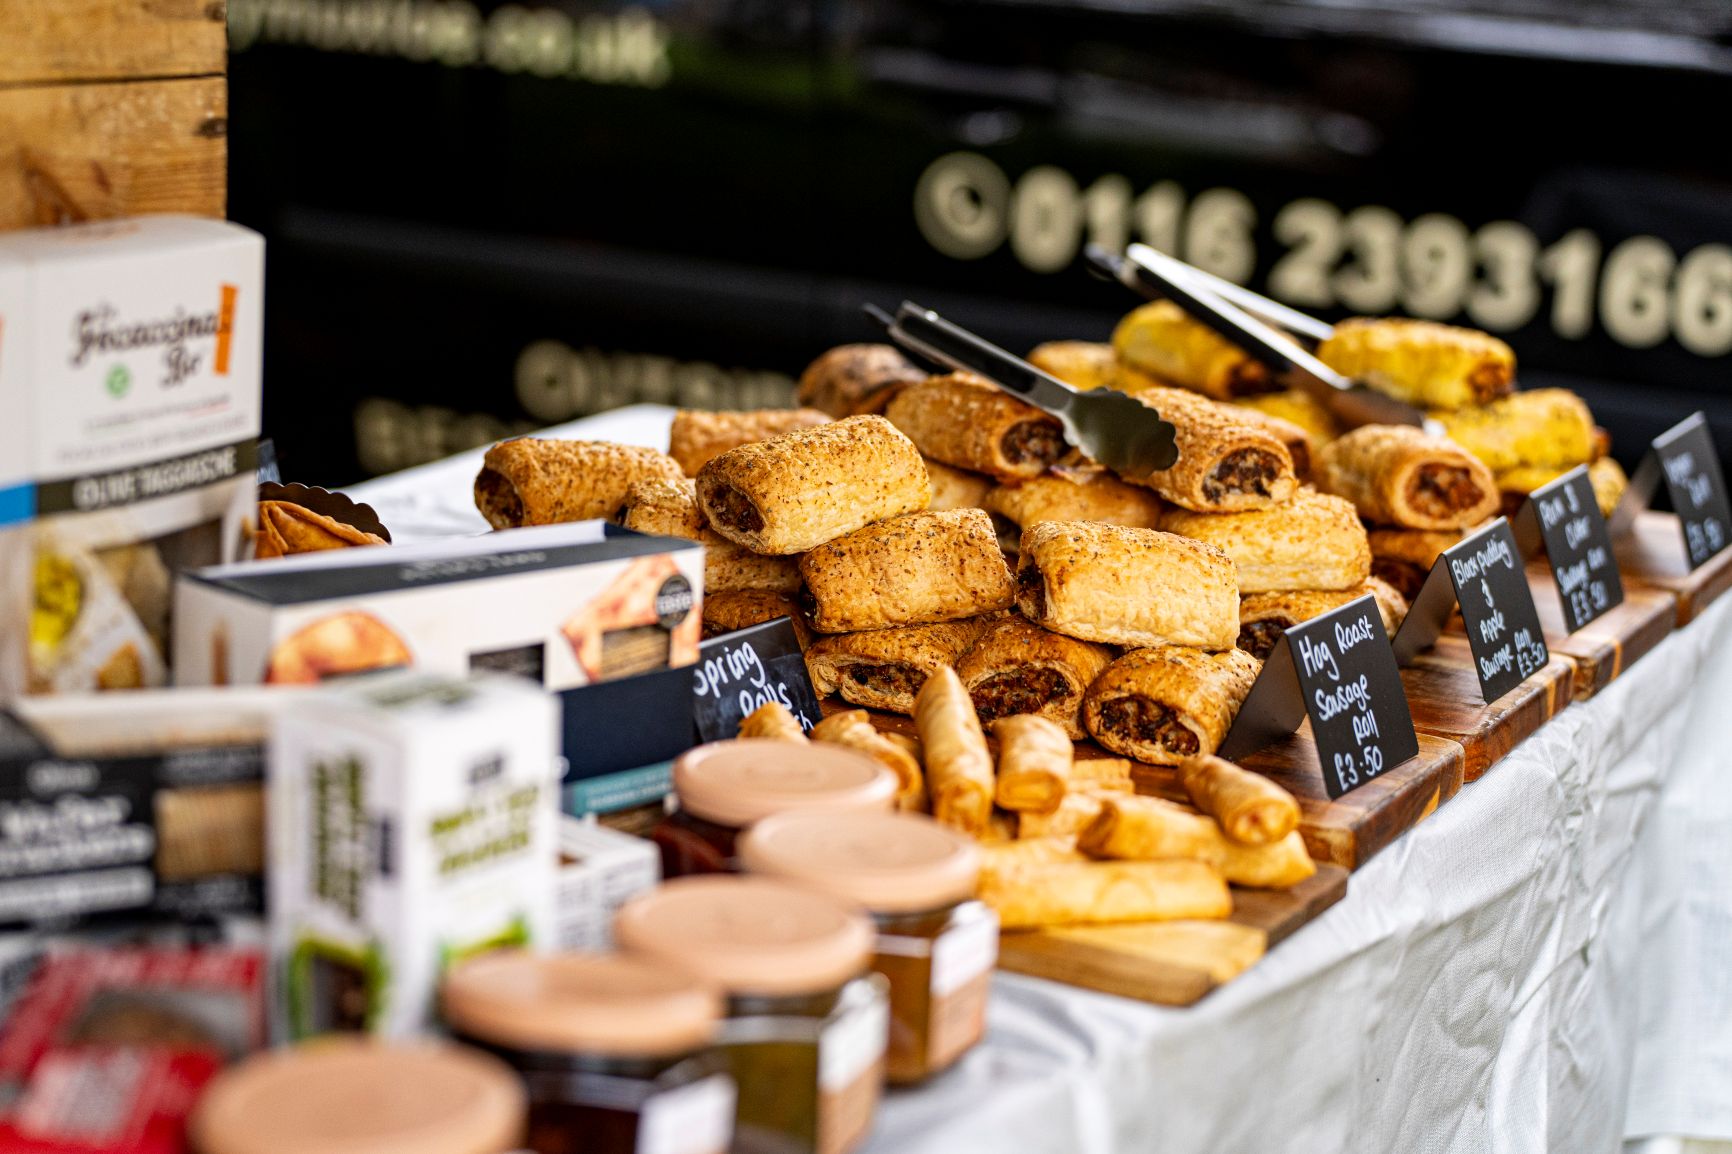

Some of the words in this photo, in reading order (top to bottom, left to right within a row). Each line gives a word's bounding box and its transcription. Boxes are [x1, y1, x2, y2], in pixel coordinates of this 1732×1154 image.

[1268, 198, 1732, 357] 2393166
[1451, 557, 1478, 589] Black
[1298, 635, 1340, 681] Hog
[1334, 615, 1374, 655] Roast
[1479, 608, 1506, 644] Apple
[1314, 673, 1371, 721] Sausage
[1352, 708, 1380, 746] Roll
[1333, 745, 1384, 792] £3.50
